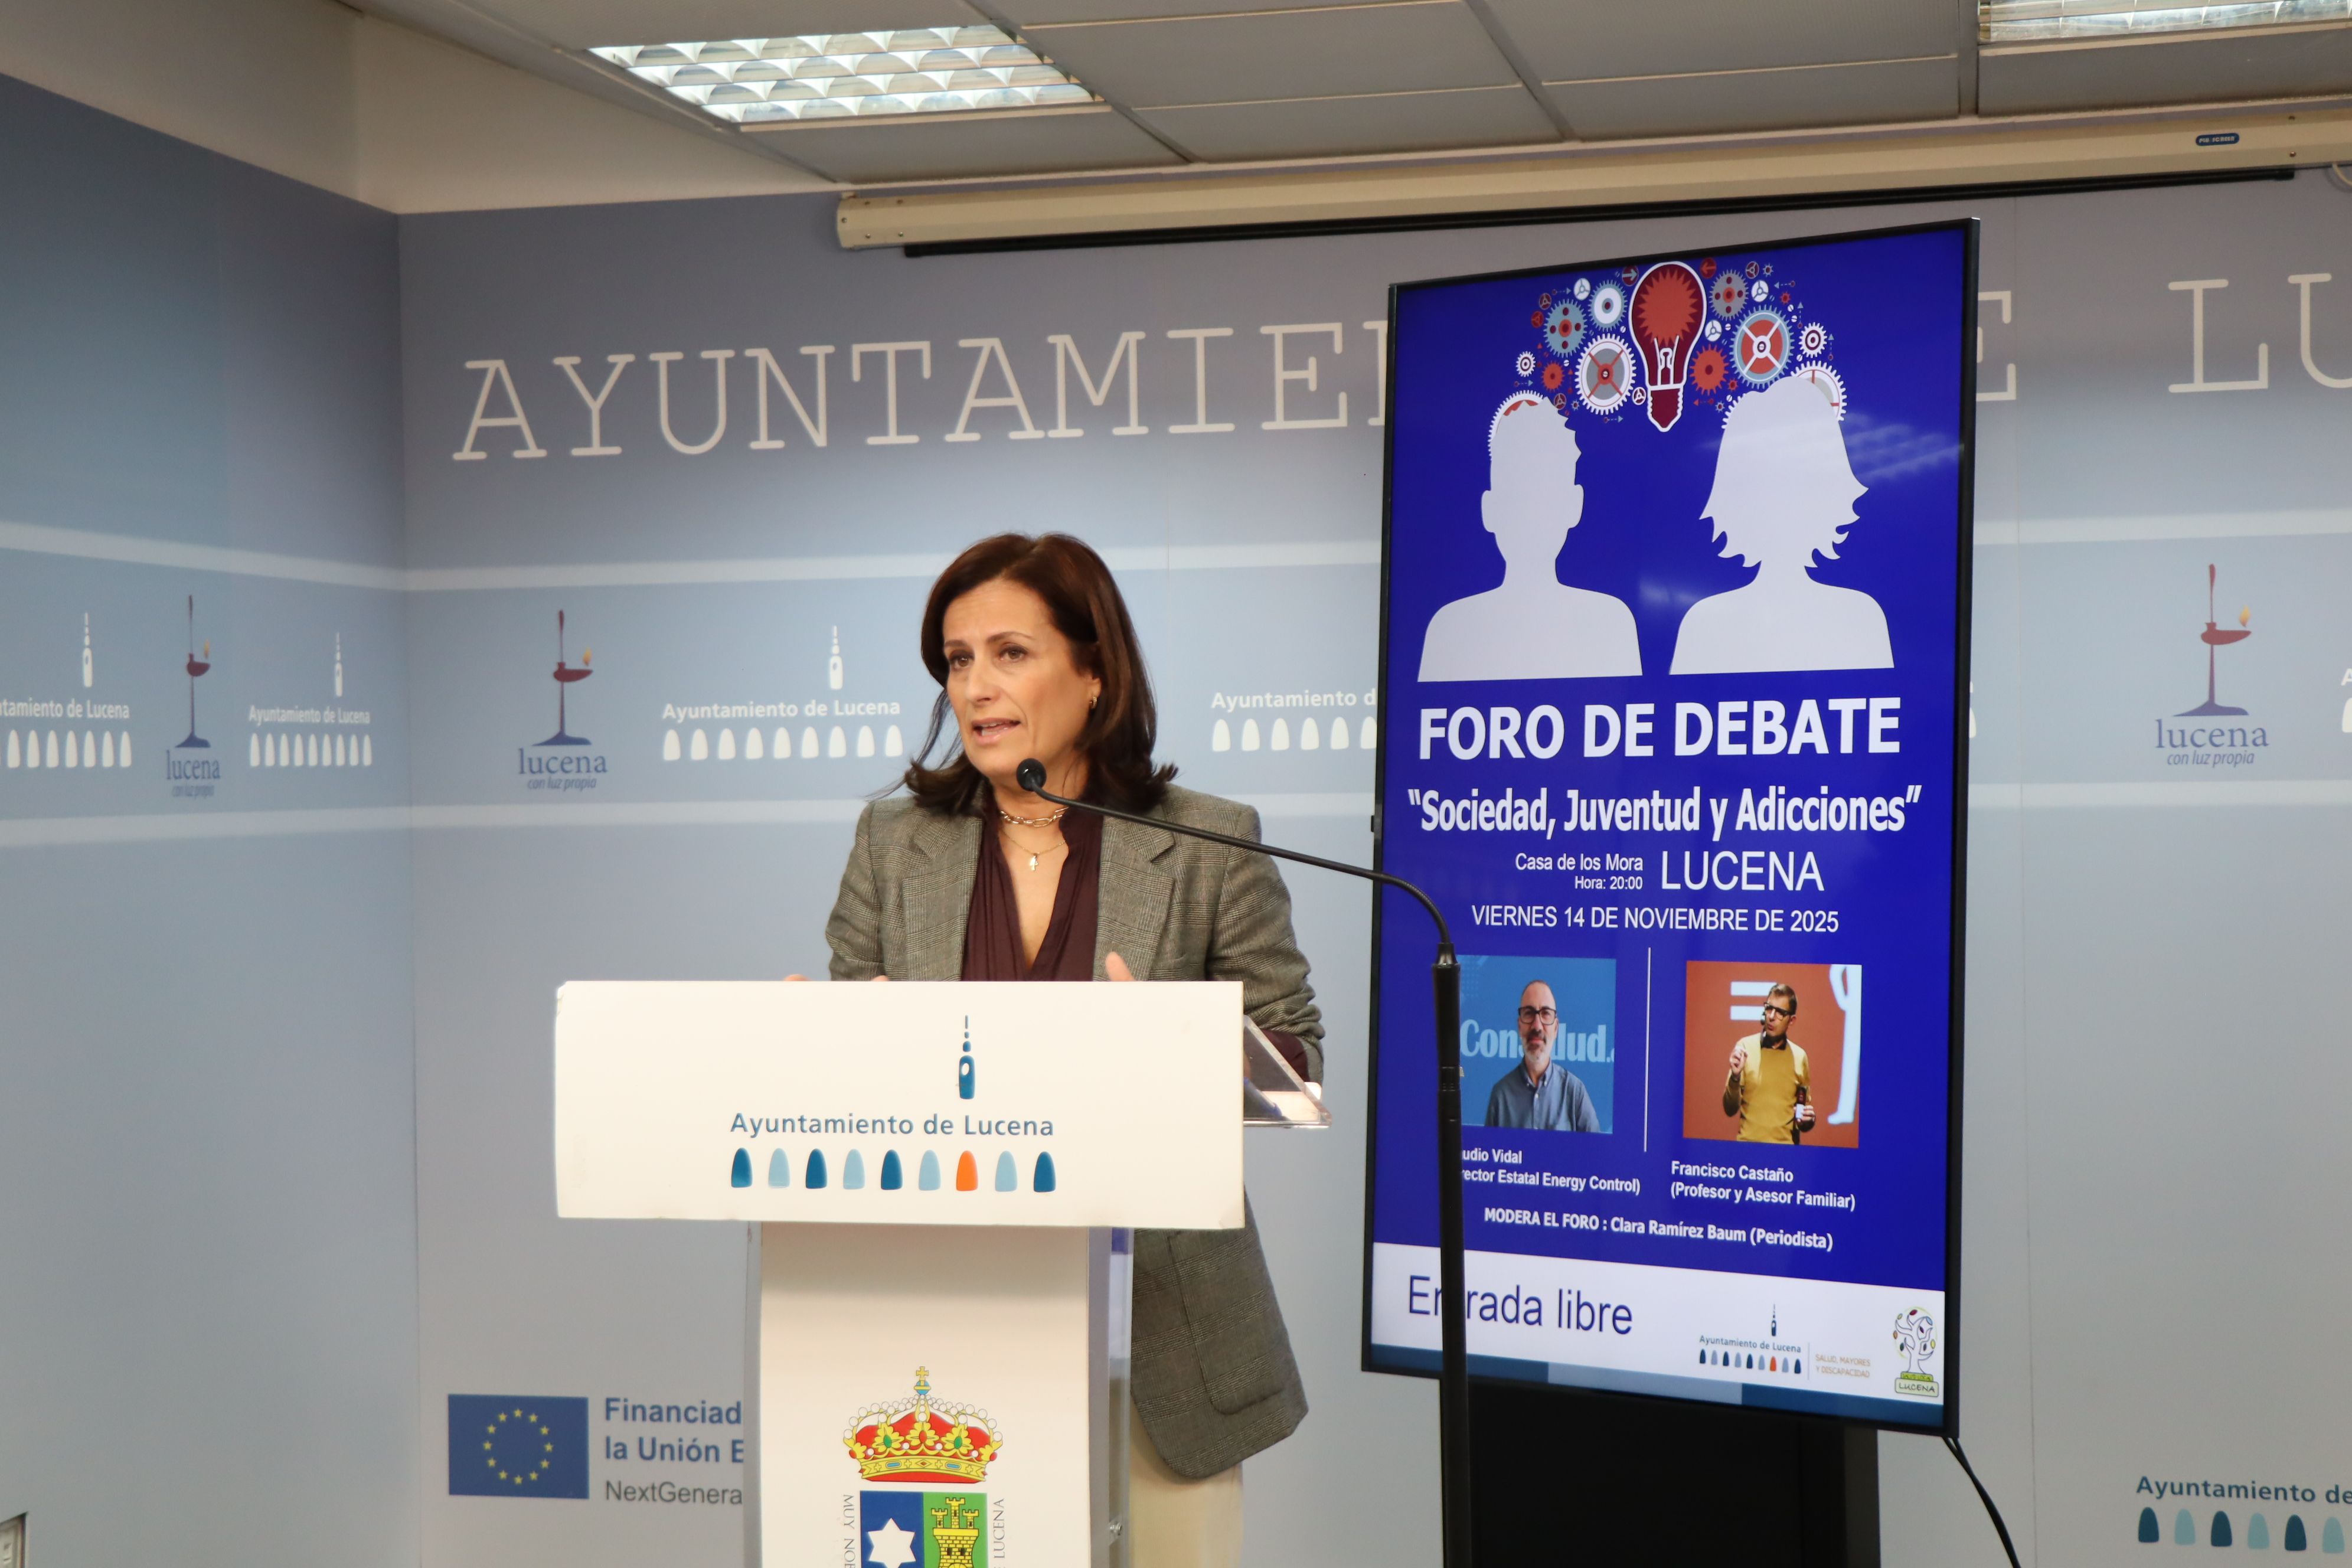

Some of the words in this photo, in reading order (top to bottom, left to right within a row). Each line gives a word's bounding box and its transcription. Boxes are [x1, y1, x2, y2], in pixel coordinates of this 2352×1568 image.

[0, 697, 63, 717] tamiento
[67, 698, 83, 717] de
[87, 699, 129, 718] Lucena
[662, 701, 798, 723] Ayuntamiento
[805, 700, 828, 716] de
[834, 700, 900, 716] Lucena
[1211, 690, 1357, 713] Ayuntamiento
[249, 705, 321, 726] Ayuntamiento
[324, 706, 335, 723] de
[338, 707, 370, 724] Lucena
[1419, 704, 1564, 760] FORO
[1584, 703, 1654, 757] DE
[1675, 697, 1900, 756] DEBATE
[2155, 718, 2269, 748] lucena
[166, 749, 221, 780] lucena
[518, 747, 607, 775] lucena
[2167, 754, 2188, 765] con
[2192, 750, 2211, 765] luz
[2212, 750, 2255, 767] propia
[1563, 786, 1701, 833] Juventud
[1711, 797, 1729, 841] y
[1515, 853, 1553, 871] Casa
[1557, 854, 1576, 871] de
[1580, 854, 1601, 871] los
[1605, 854, 1643, 871] Mora
[1661, 851, 1825, 891] LUCENA
[1574, 876, 1606, 890] Hora:
[1609, 876, 1643, 890] 20:00
[1472, 905, 1557, 927] VIERNES
[1564, 907, 1585, 927] 14
[1591, 907, 1618, 928] DE
[1625, 907, 1749, 930] NOVIEMBRE
[1755, 910, 1783, 931] DE
[1790, 910, 1839, 932] 2025
[730, 1112, 914, 1138] Ayuntamiento
[923, 1114, 954, 1135] de
[965, 1115, 1054, 1136] Lucena
[1491, 1149, 1523, 1164] Vidal
[1498, 1169, 1540, 1185] Estatal
[1542, 1172, 1587, 1192] Energy
[1589, 1175, 1641, 1196] Control)
[1671, 1161, 1736, 1178] Francisco
[1739, 1165, 1794, 1182] Castaño
[1670, 1181, 1732, 1200] (Profesor
[1734, 1188, 1743, 1203] y
[1745, 1187, 1794, 1204] Asesor
[1796, 1190, 1856, 1212] Familiar)
[1484, 1207, 1541, 1226] MODERA
[1543, 1212, 1560, 1227] EL
[1562, 1213, 1599, 1230] FORO
[1610, 1217, 1646, 1234] Clara
[1648, 1220, 1704, 1239] Ramírez
[1707, 1224, 1747, 1242] Baum
[1750, 1227, 1834, 1252] (Periodista)
[1409, 1275, 1543, 1327] Erada
[1558, 1288, 1633, 1335] libre
[1700, 1335, 1758, 1349] Ayuntamiento
[1759, 1341, 1770, 1350] de
[1772, 1342, 1802, 1353] Lucena
[1899, 1382, 1936, 1393] LUCENA
[605, 1397, 742, 1425] Financiad
[605, 1436, 628, 1459] la
[638, 1437, 720, 1462] Unión
[605, 1480, 743, 1505] NextGenera
[2137, 1476, 2315, 1502] Ayuntamiento
[2325, 1485, 2352, 1505] de
[843, 1494, 855, 1530] MUY
[993, 1498, 1005, 1559] LUCENA
